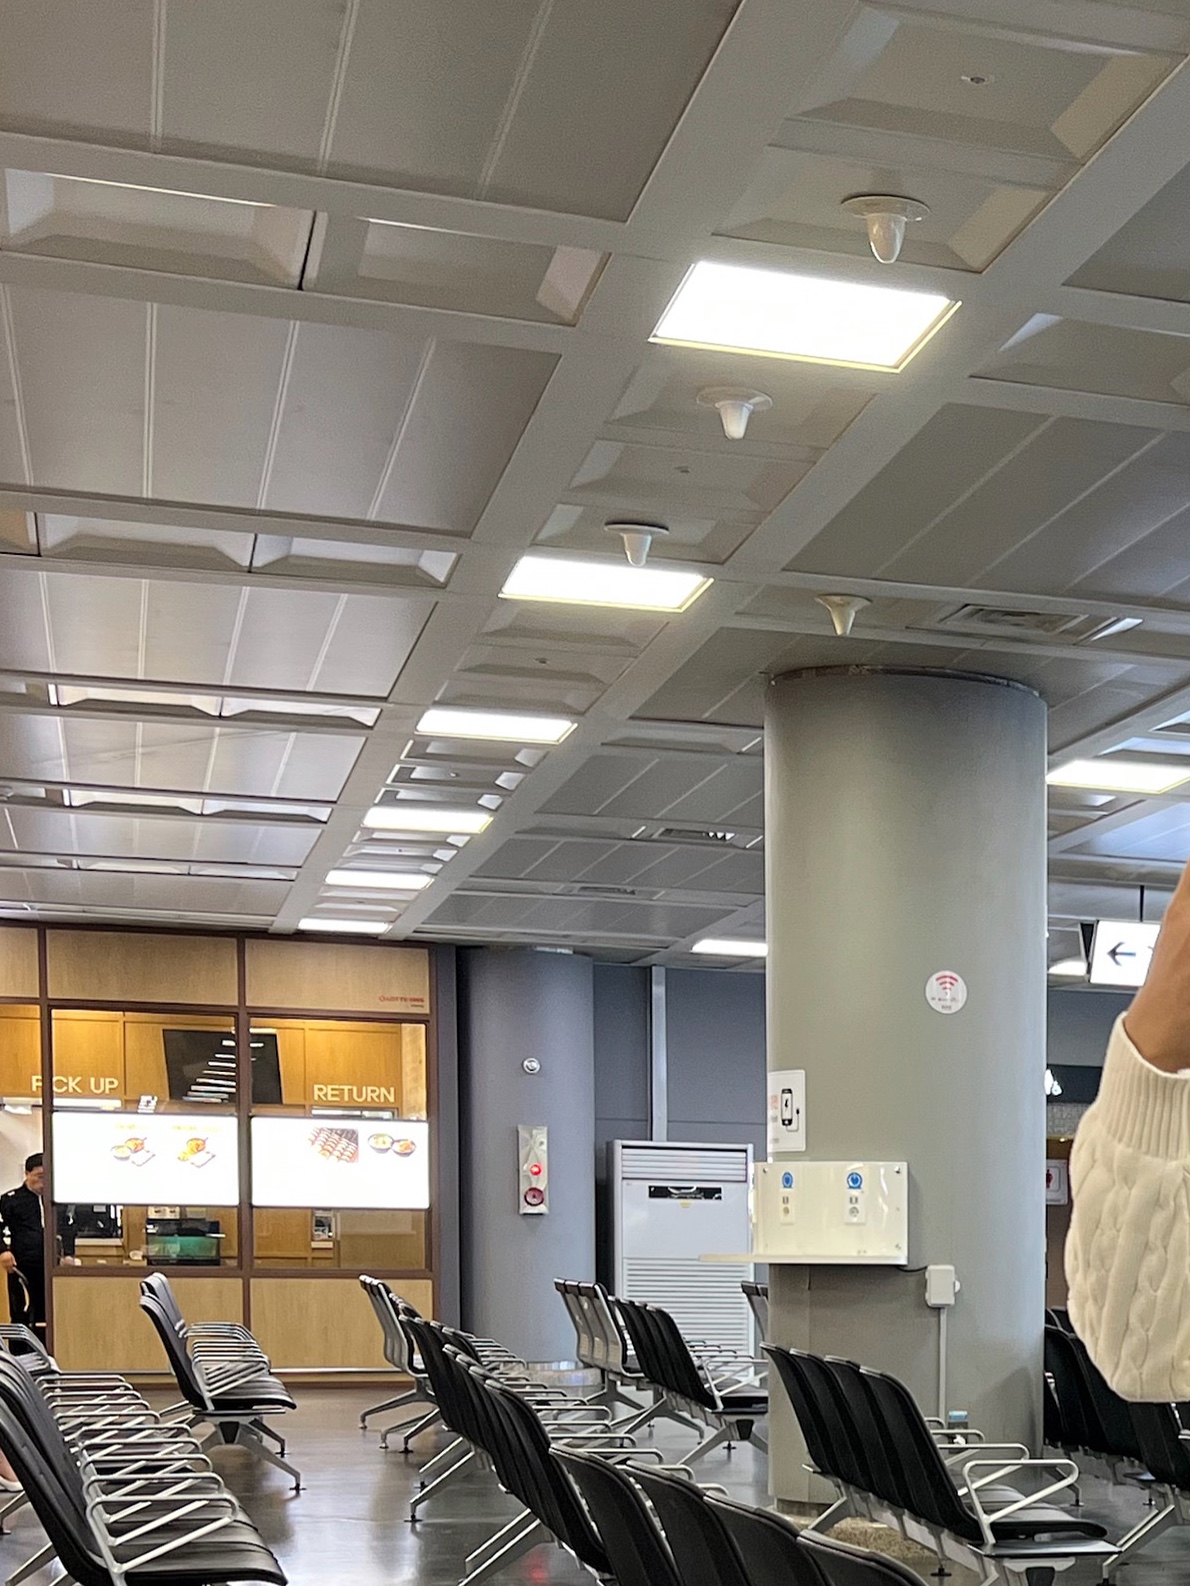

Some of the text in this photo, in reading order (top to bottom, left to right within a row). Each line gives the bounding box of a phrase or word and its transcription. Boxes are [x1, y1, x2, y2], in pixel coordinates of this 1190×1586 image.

[31, 1075, 119, 1095] PCK UP
[313, 1084, 395, 1103] RETURN
